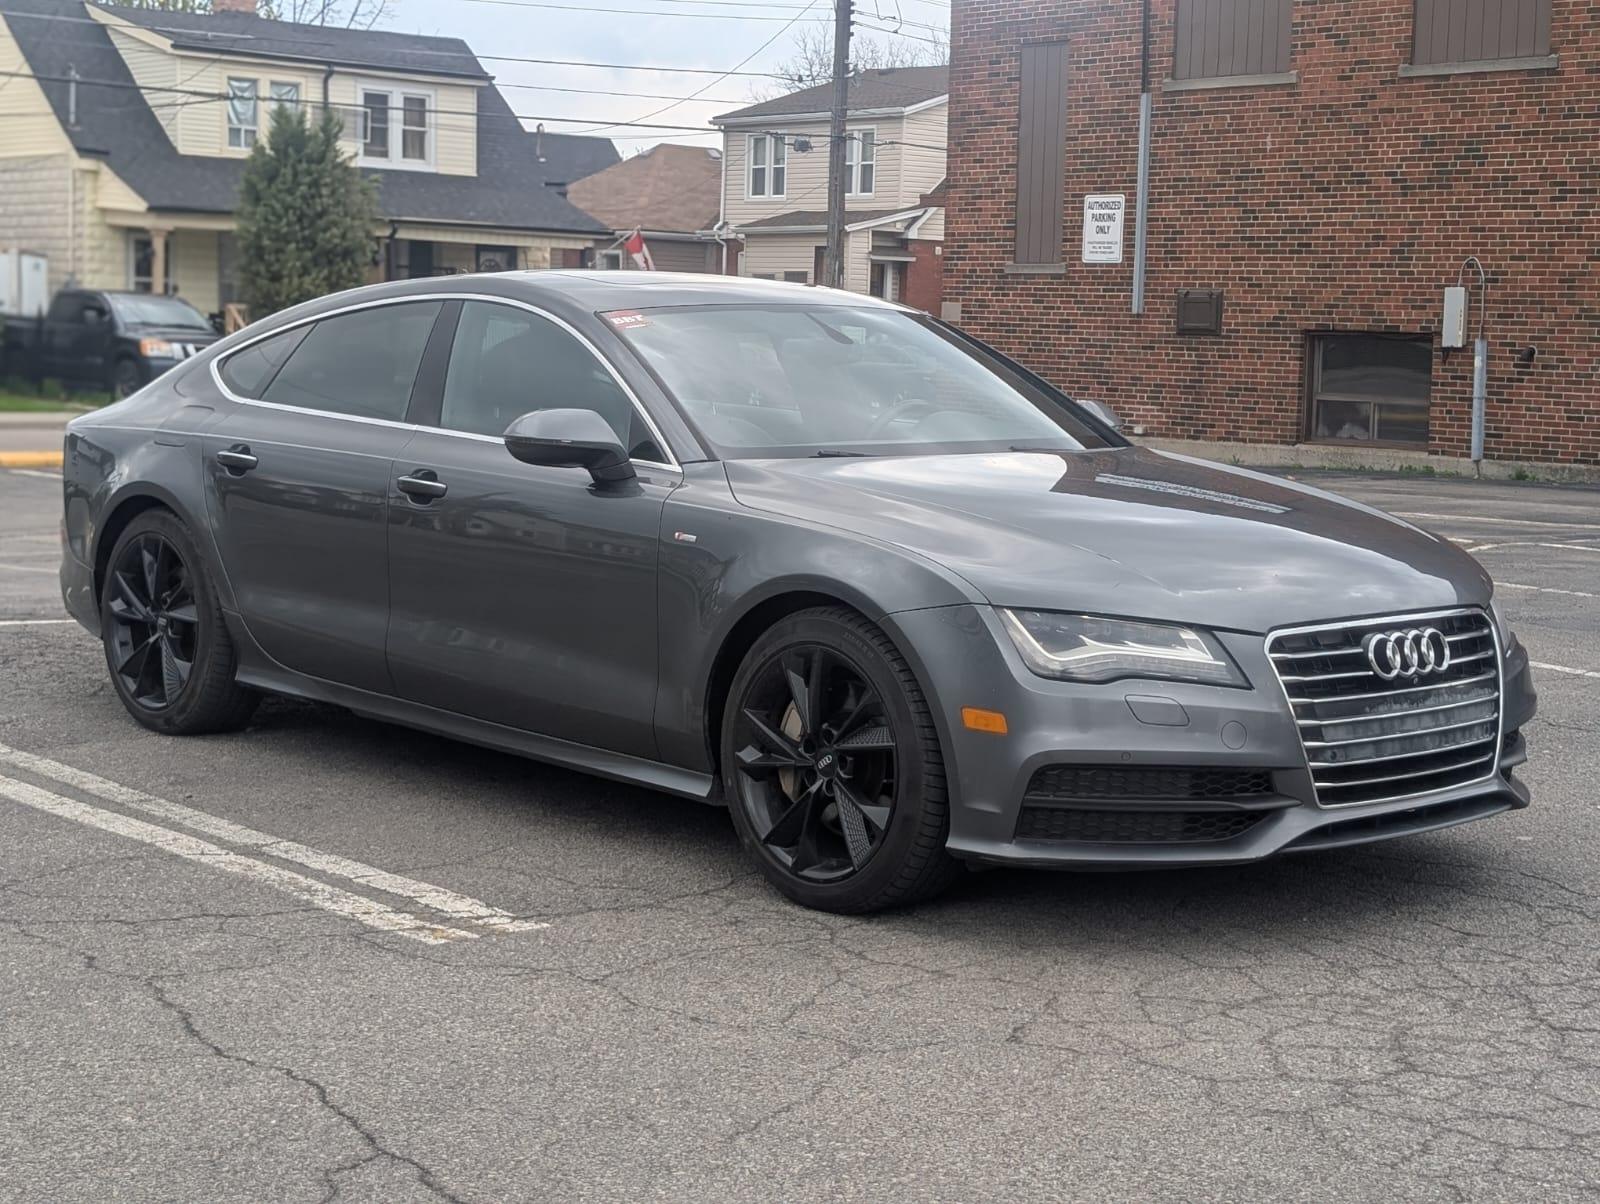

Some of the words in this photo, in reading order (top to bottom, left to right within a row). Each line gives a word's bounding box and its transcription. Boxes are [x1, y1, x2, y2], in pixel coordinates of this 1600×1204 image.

[1088, 200, 1122, 210] AUTHORIZED
[1091, 212, 1116, 222] PARKING
[1095, 225, 1110, 235] ONLY
